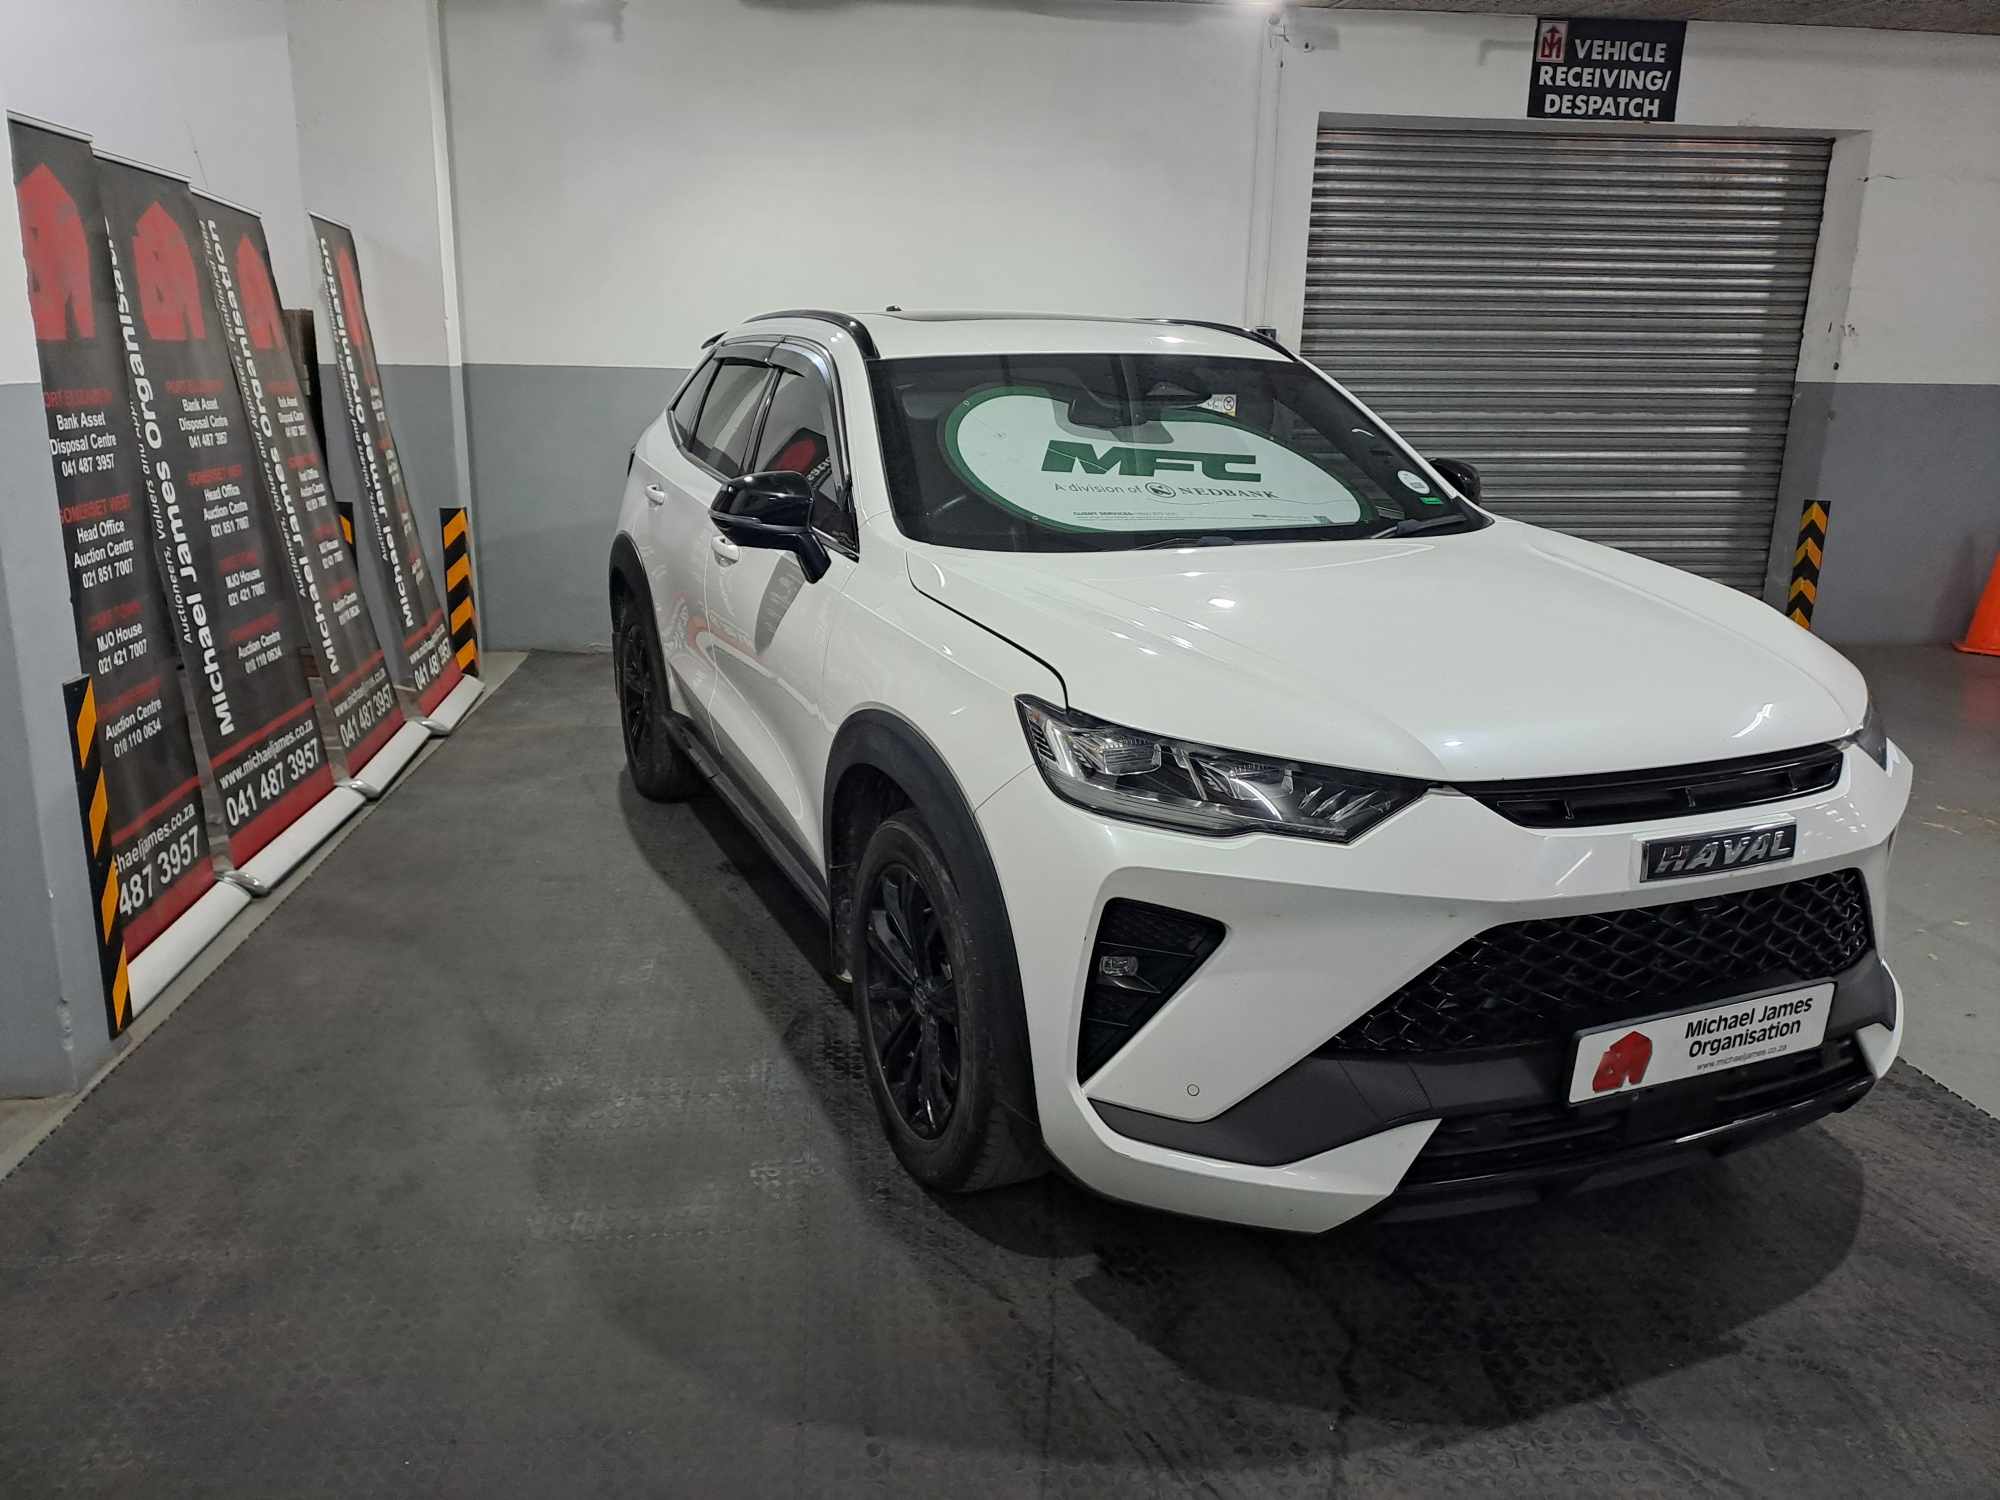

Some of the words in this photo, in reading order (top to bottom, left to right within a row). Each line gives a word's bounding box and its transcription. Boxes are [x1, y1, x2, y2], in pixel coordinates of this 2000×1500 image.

[1574, 39, 1667, 63] VEHICLE
[1538, 66, 1672, 91] RECEIVING/
[1544, 94, 1660, 118] DESPATCH
[208, 219, 273, 438] Organisation
[56, 413, 79, 430] Bank
[81, 411, 106, 428] Asset
[50, 435, 89, 456] Disposal
[90, 432, 117, 449] Centre
[1041, 439, 1262, 482] MFC
[62, 460, 77, 477] 041
[79, 457, 93, 473] 487
[96, 454, 115, 471] 3957
[363, 431, 389, 518] James
[146, 480, 166, 540] Valuers
[270, 447, 305, 548] James
[1055, 482, 1067, 492] A
[1068, 483, 1127, 495] division
[1128, 484, 1144, 495] of
[1178, 487, 1281, 499] NEDBANK
[77, 524, 98, 544] Head
[99, 519, 125, 537] Office
[156, 460, 198, 583] James
[74, 547, 106, 568] Auction
[107, 540, 134, 557] Centre
[82, 569, 97, 588] 021
[97, 564, 113, 583] 851
[114, 558, 133, 577] 7007
[163, 546, 193, 644] Auctioneers,
[383, 525, 414, 628] Michael
[299, 556, 340, 675] Michael
[97, 631, 115, 652] MJO
[115, 623, 143, 643] House
[98, 656, 112, 674] 021
[113, 647, 127, 666] 421
[129, 639, 147, 659] 7007
[187, 593, 235, 736] Michael
[106, 713, 136, 740] Auction
[136, 699, 162, 720] Centre
[339, 713, 361, 748] 041
[358, 699, 376, 730] 487
[372, 683, 394, 717] 3957
[114, 738, 127, 758] 010
[129, 729, 142, 747] 110
[143, 717, 162, 738] 0634
[219, 719, 314, 790] www.michaeljames.co.za
[227, 783, 258, 827] 041
[260, 761, 286, 801] 487
[287, 737, 320, 781] 3957
[119, 863, 153, 915] 487
[158, 825, 198, 884] 3957
[1655, 831, 1791, 874] HAVAL
[1685, 1007, 1756, 1040] Michael
[1758, 998, 1814, 1025] James
[1689, 1019, 1802, 1058] Organisation
